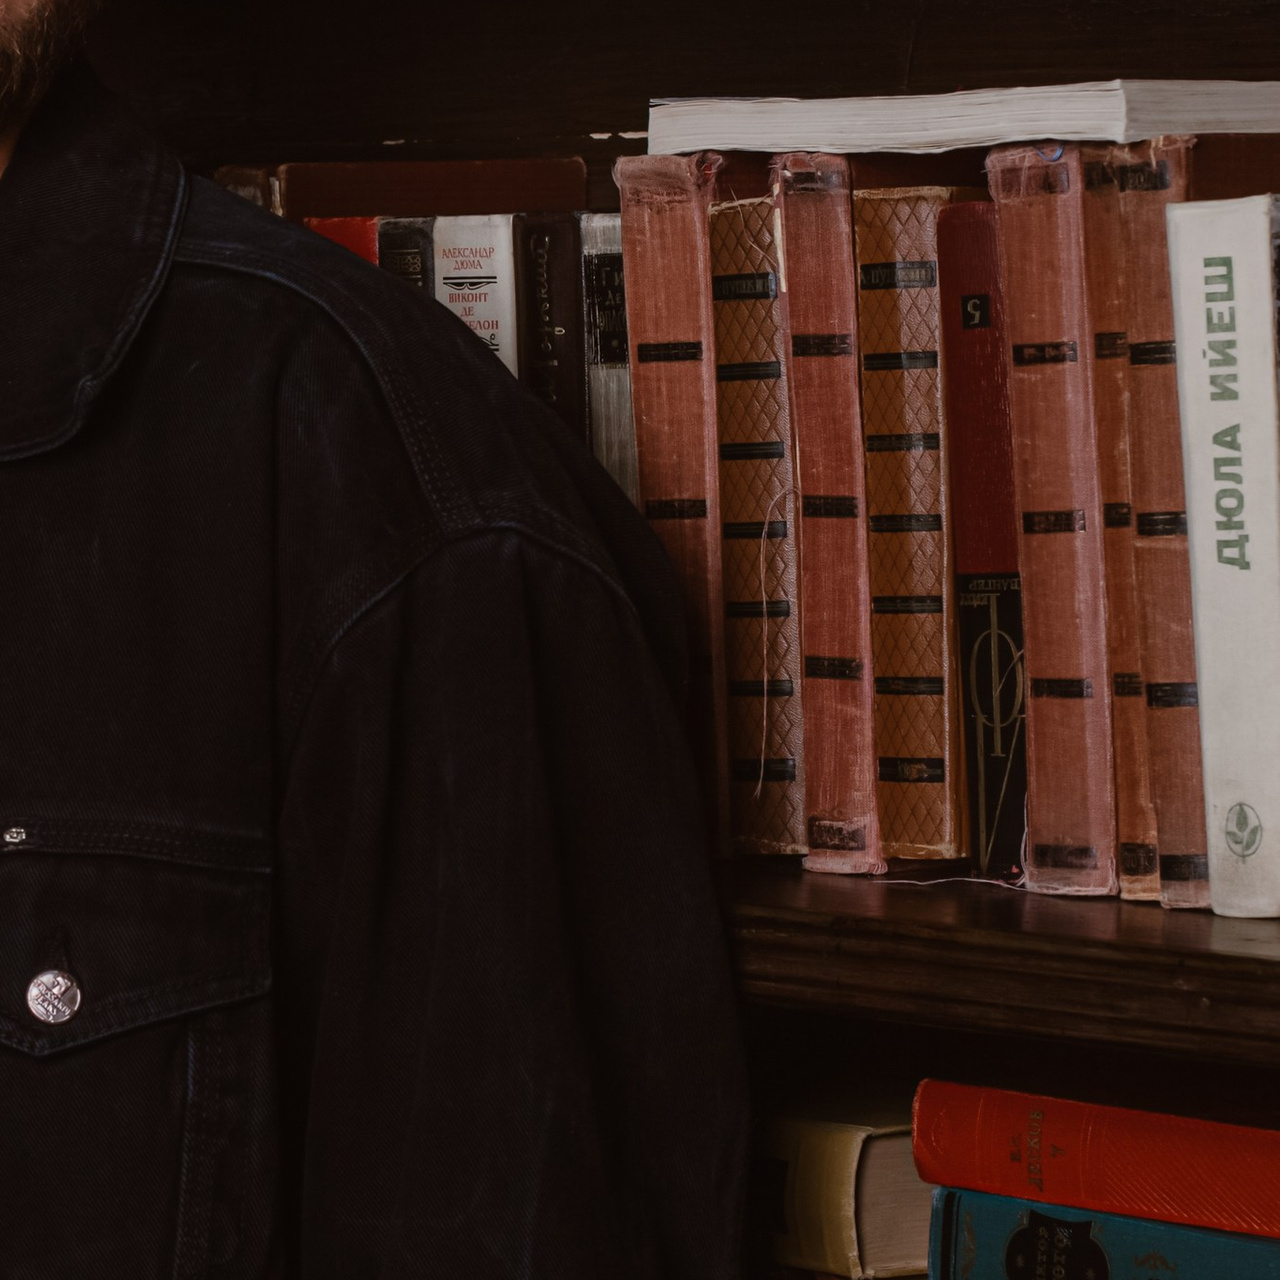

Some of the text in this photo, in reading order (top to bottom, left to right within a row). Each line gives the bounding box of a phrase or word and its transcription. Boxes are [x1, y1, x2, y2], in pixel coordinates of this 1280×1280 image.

[441, 247, 495, 259] АЛЕКСАНДР
[453, 259, 482, 271] ДЮМА
[448, 293, 488, 303] ВИКОНТ
[460, 306, 475, 317] ДЕ
[967, 299, 980, 325] 5
[466, 320, 499, 330] ЕЛОН
[1202, 255, 1251, 570] ДЮЛА ИЙЕШ
[968, 579, 1020, 591] ВАНГЕР
